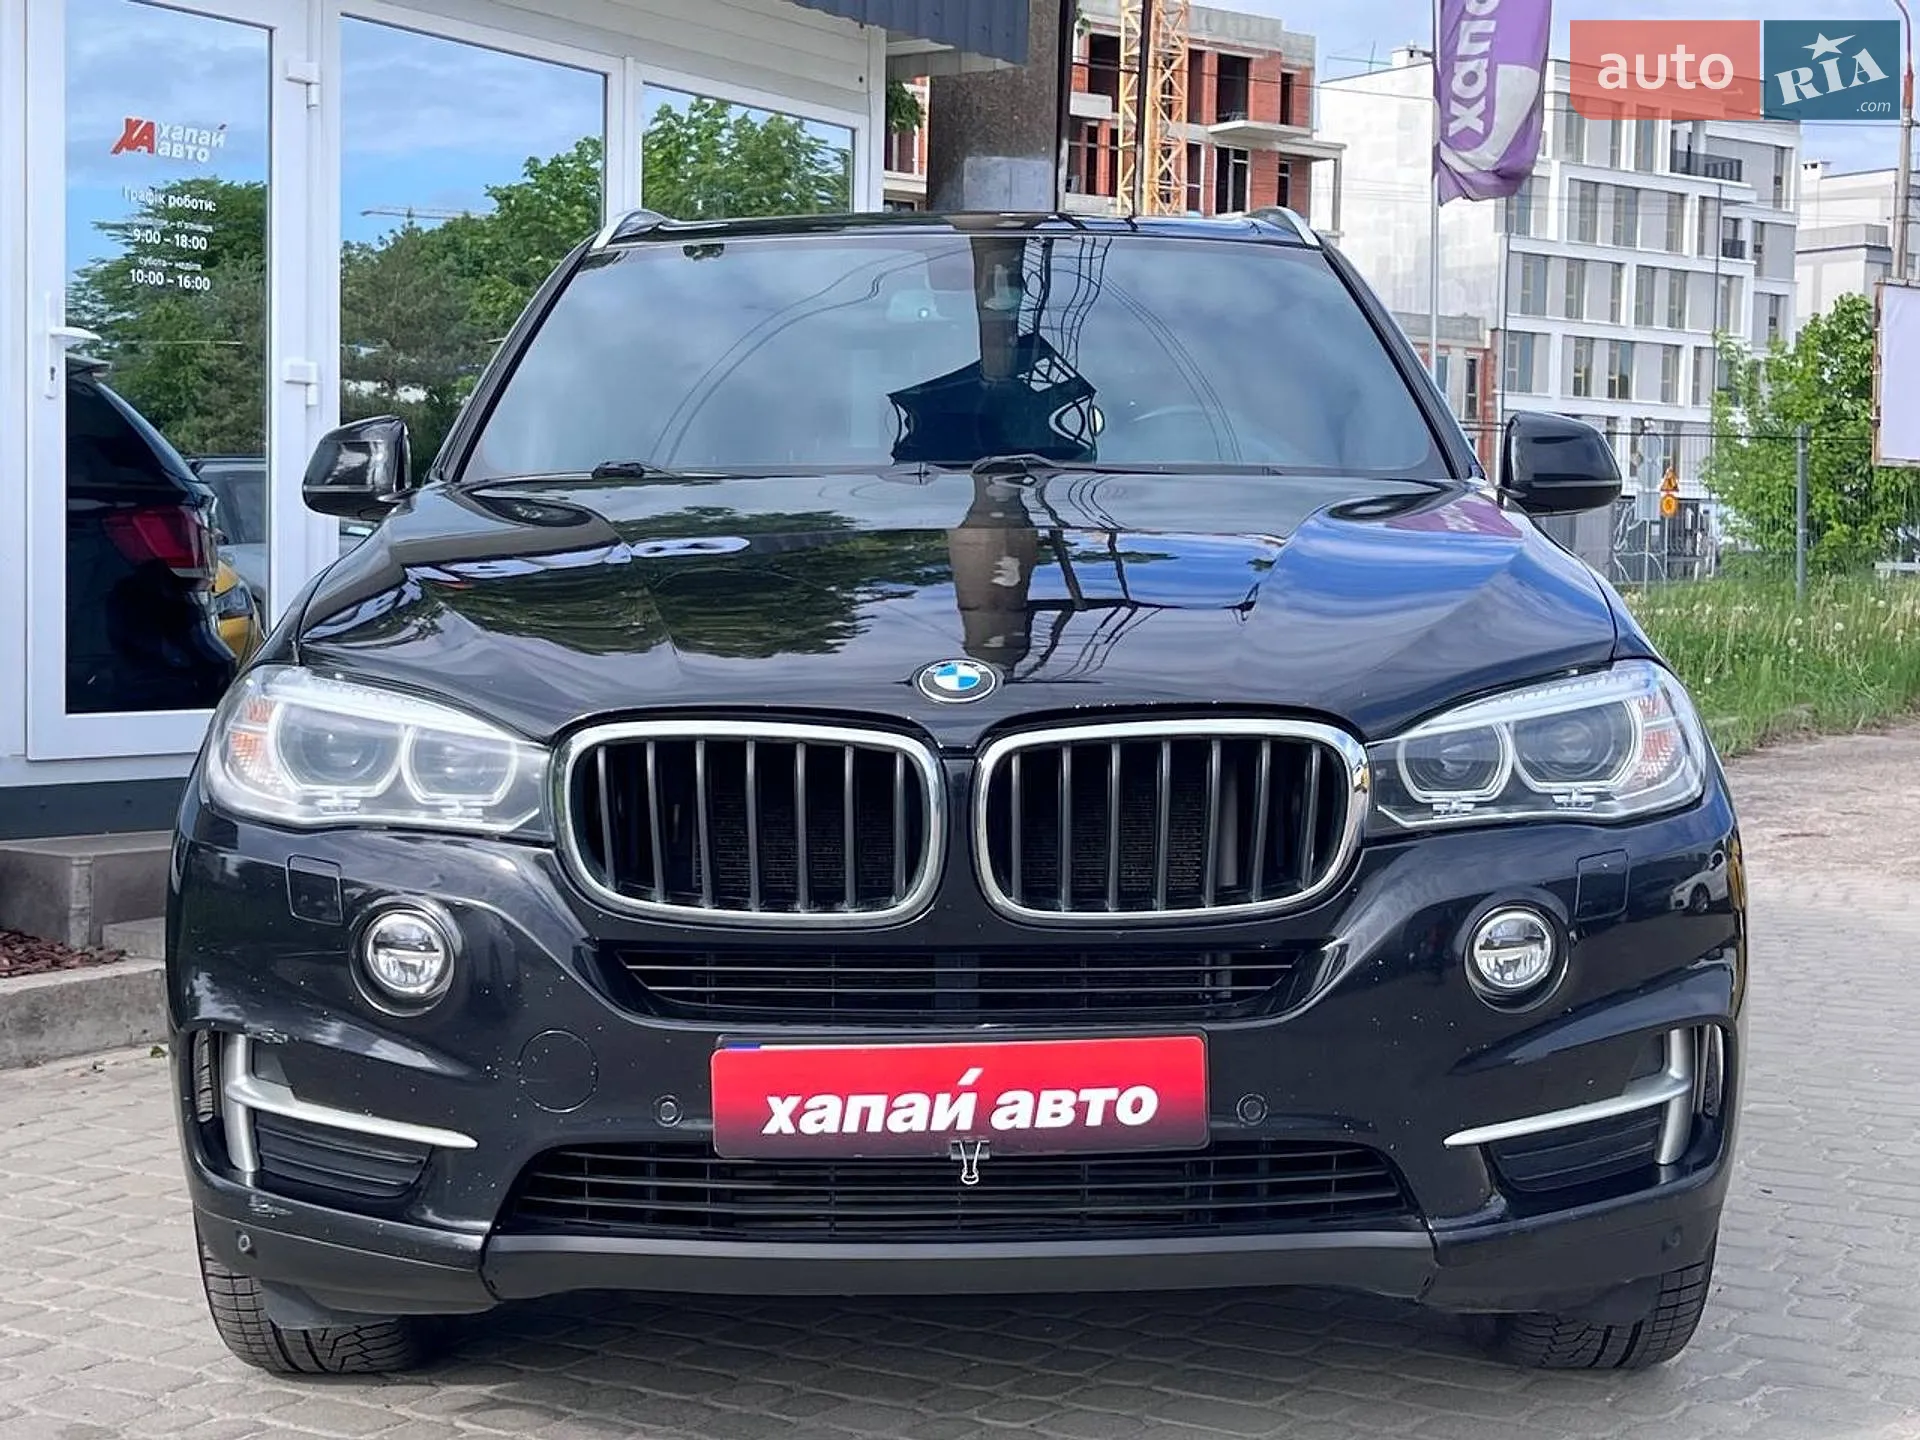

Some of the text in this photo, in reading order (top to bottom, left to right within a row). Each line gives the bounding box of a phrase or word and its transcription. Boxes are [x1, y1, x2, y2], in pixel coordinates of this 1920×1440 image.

[159, 122, 226, 148] хапай
[158, 141, 209, 162] авто
[168, 194, 216, 212] роботи:
[133, 229, 160, 244] 9:00
[174, 234, 207, 250] 18:00
[130, 269, 164, 285] 10:00
[177, 275, 211, 290] 16:00
[762, 1068, 1158, 1135] хапай авто
